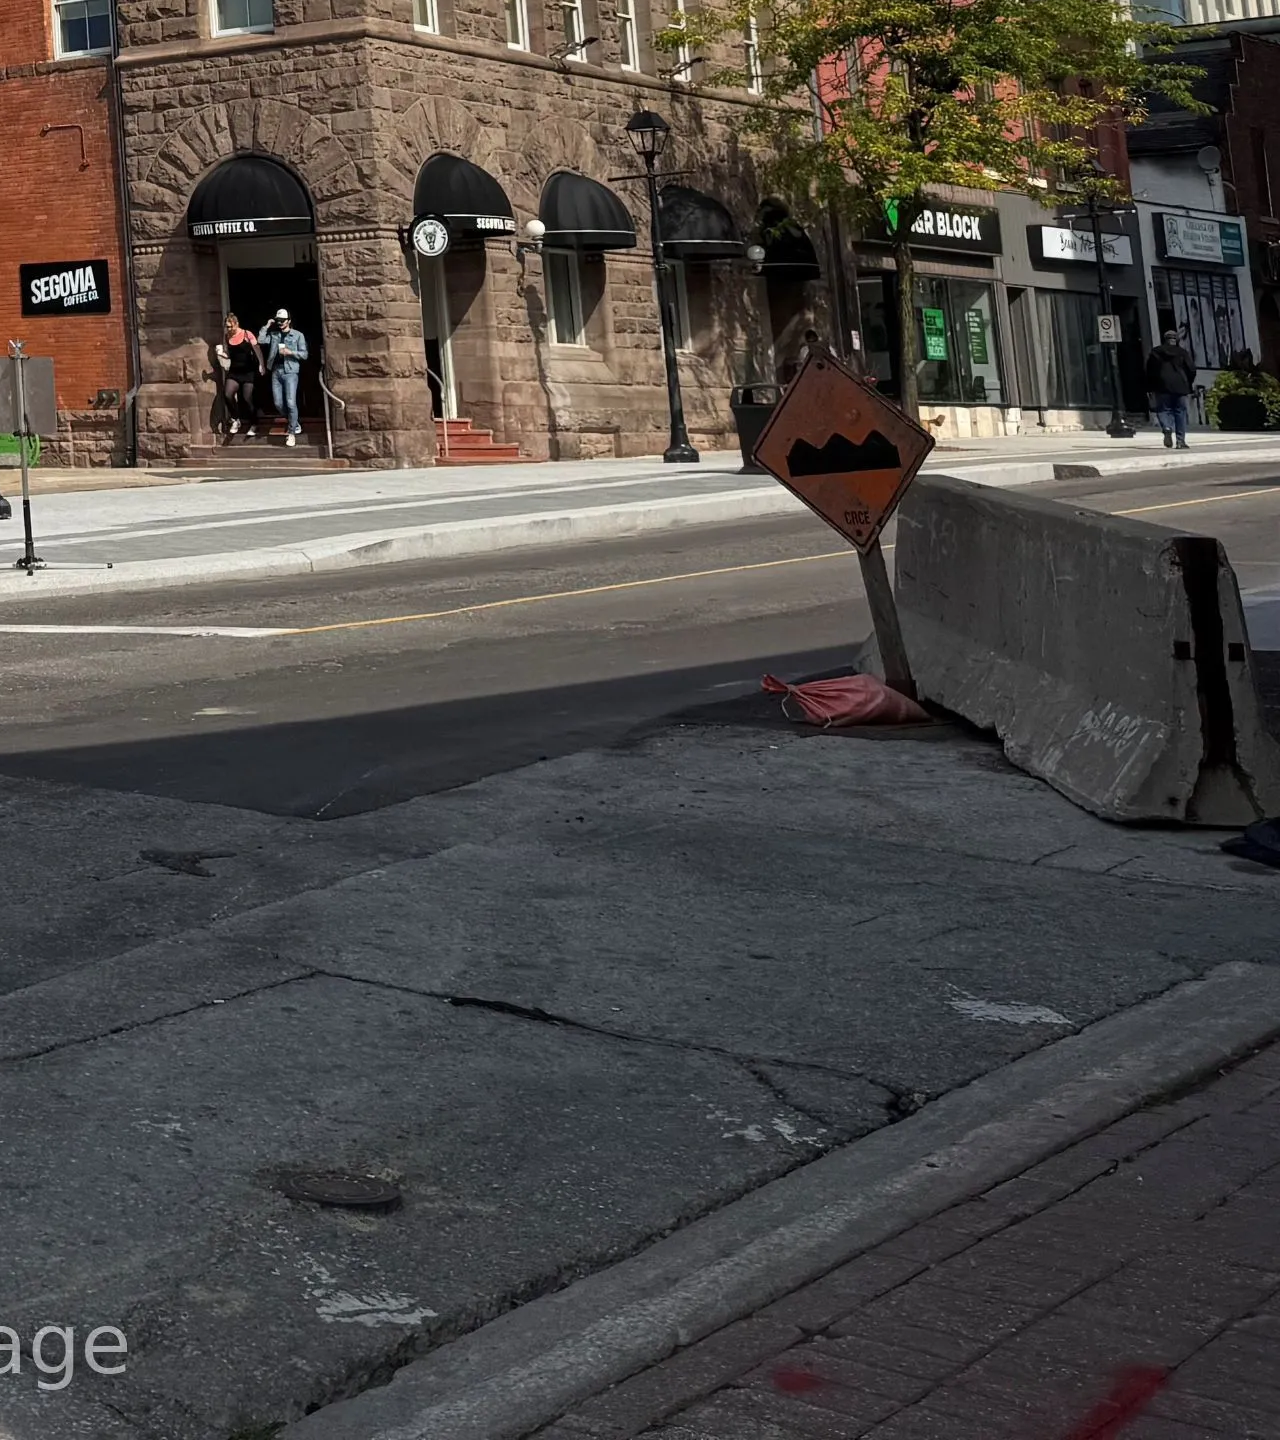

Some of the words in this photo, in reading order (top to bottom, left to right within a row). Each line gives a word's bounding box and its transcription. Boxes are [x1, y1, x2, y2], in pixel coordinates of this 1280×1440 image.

[215, 222, 242, 234] COFFEE
[243, 221, 257, 232] CO.
[936, 211, 981, 240] BLOCK
[30, 265, 96, 304] SEGOVIA
[63, 292, 88, 307] COFFEE
[88, 290, 99, 301] CO.
